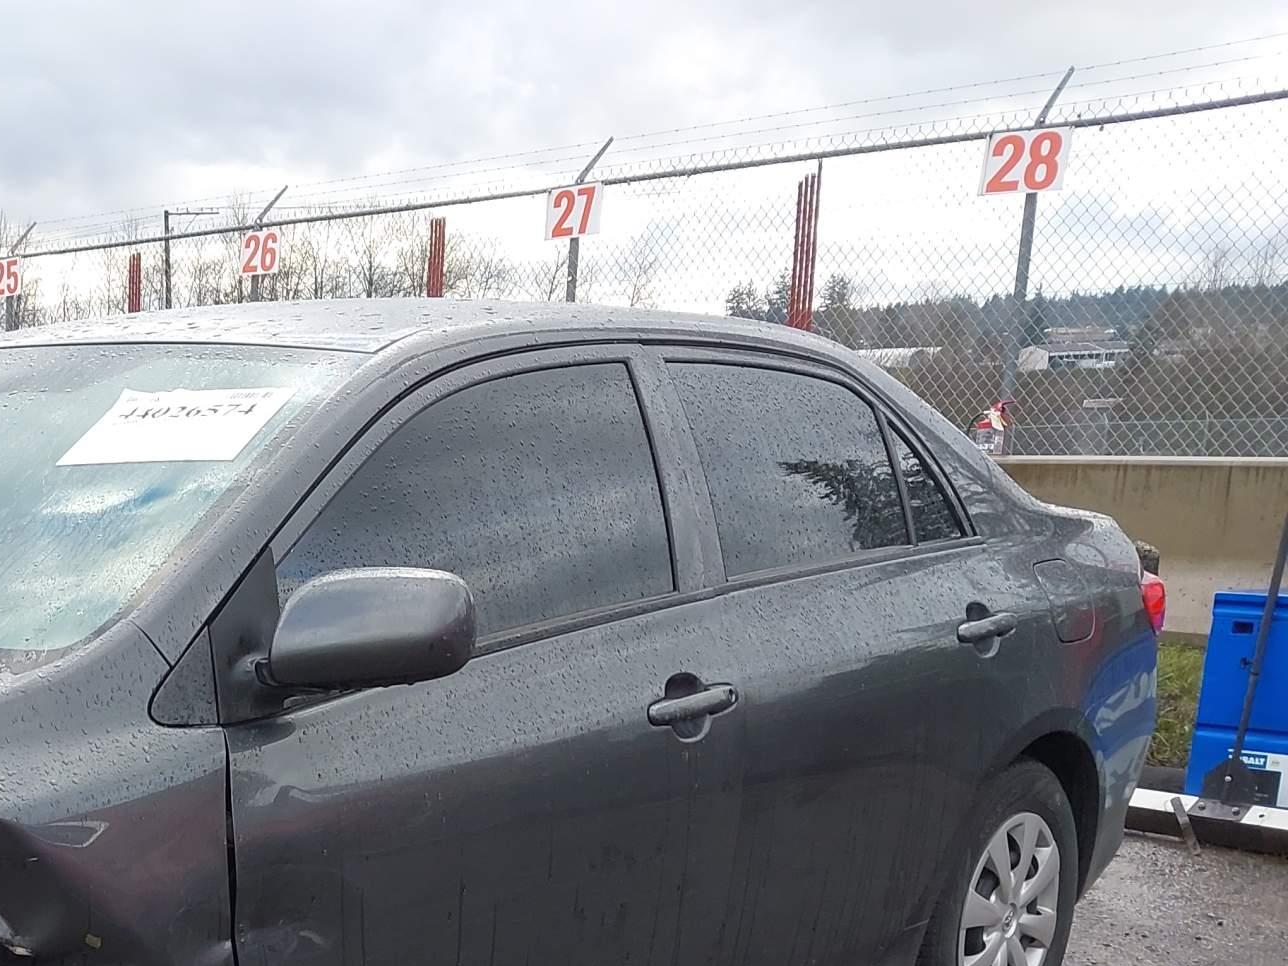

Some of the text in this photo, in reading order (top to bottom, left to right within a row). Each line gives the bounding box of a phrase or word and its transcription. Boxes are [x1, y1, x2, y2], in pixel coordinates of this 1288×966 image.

[984, 130, 1064, 193] 28
[551, 185, 596, 238] 27
[242, 232, 278, 273] 26
